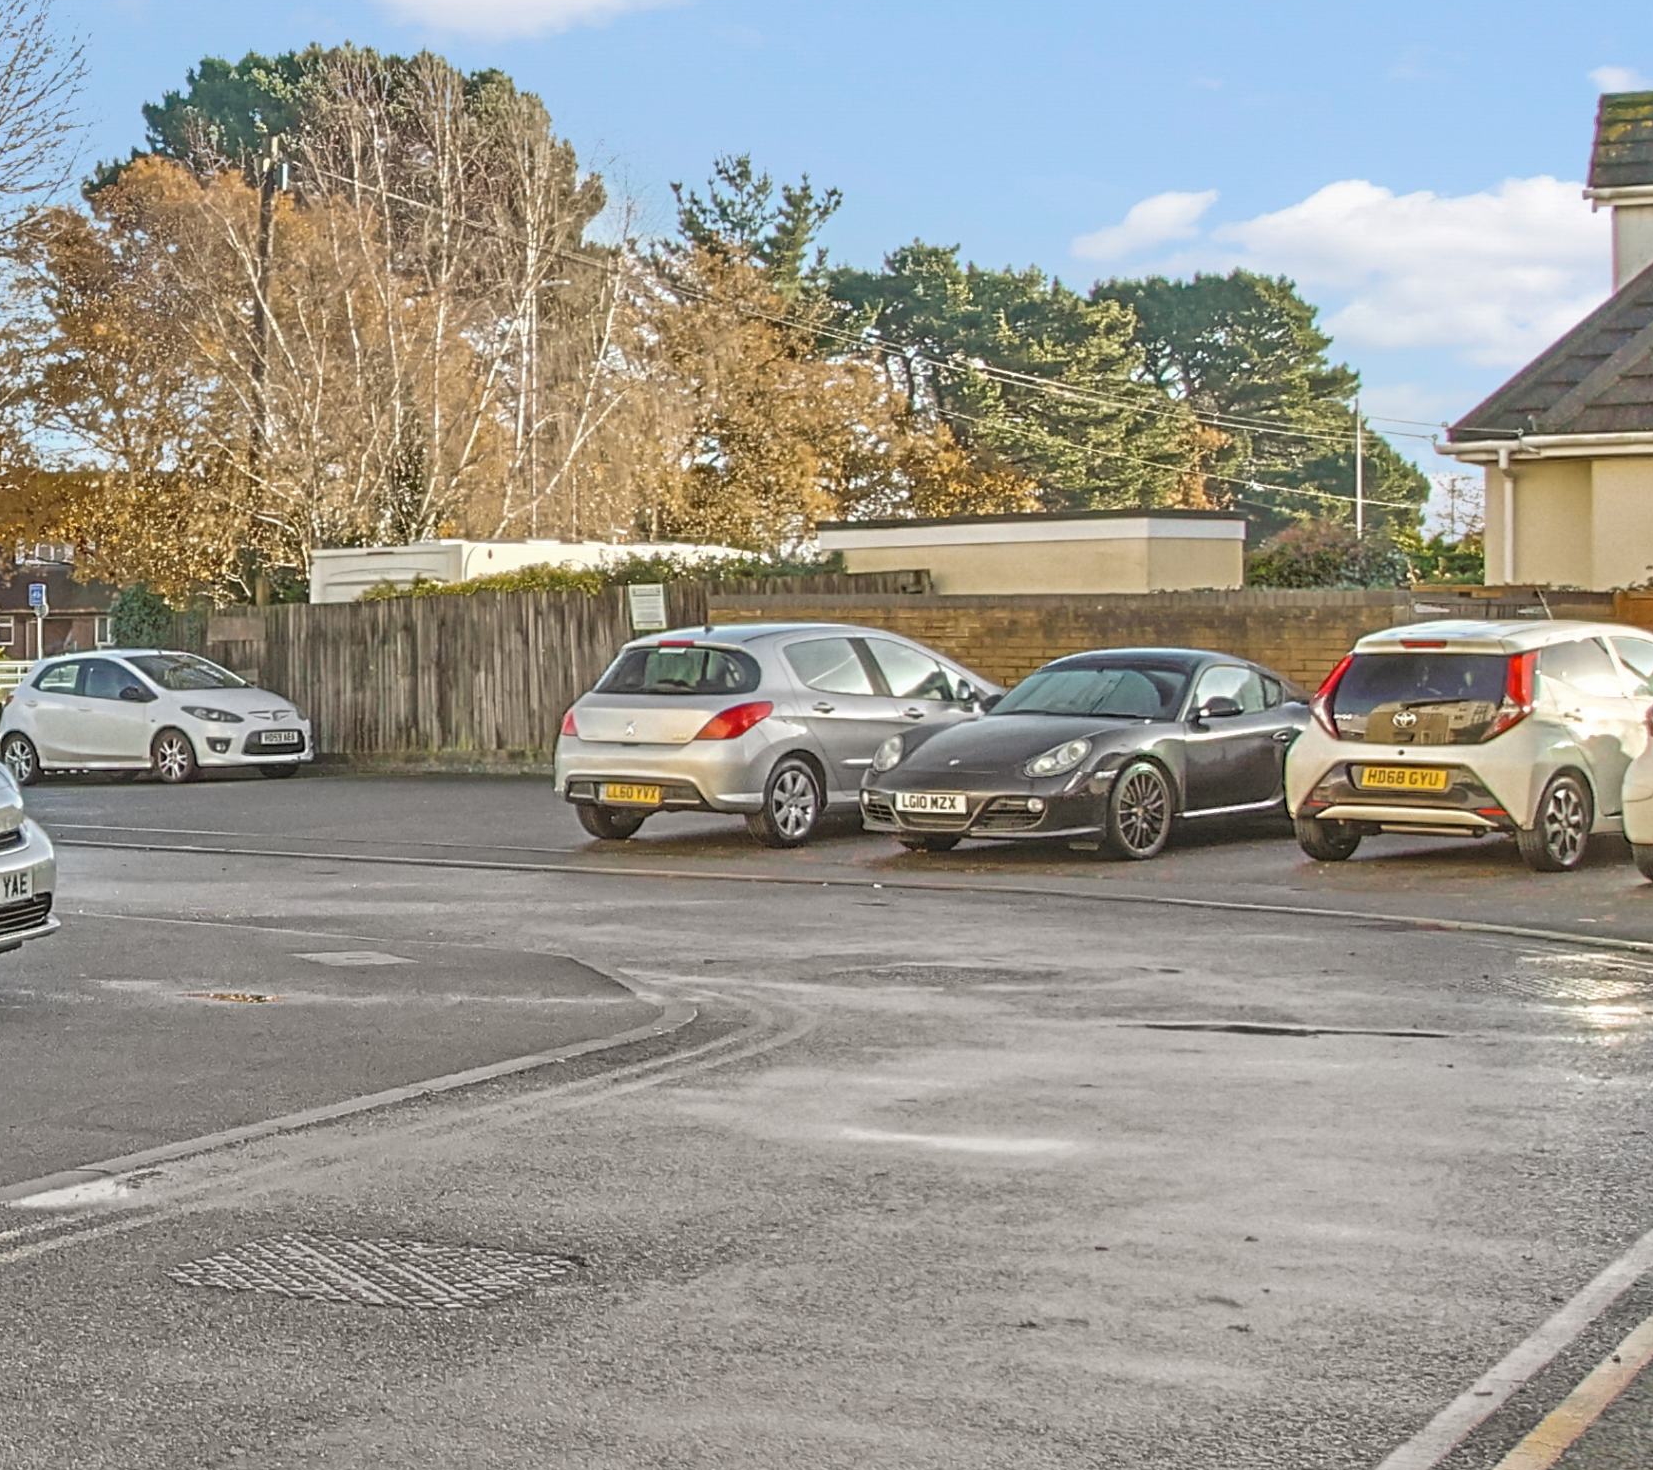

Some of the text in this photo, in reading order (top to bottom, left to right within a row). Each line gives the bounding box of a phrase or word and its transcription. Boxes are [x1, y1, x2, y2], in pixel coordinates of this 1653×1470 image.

[1367, 769, 1439, 786] HD68 GYU
[607, 785, 657, 800] LL60 YVX
[902, 794, 956, 810] LG10 MZX
[3, 872, 28, 898] YAE
